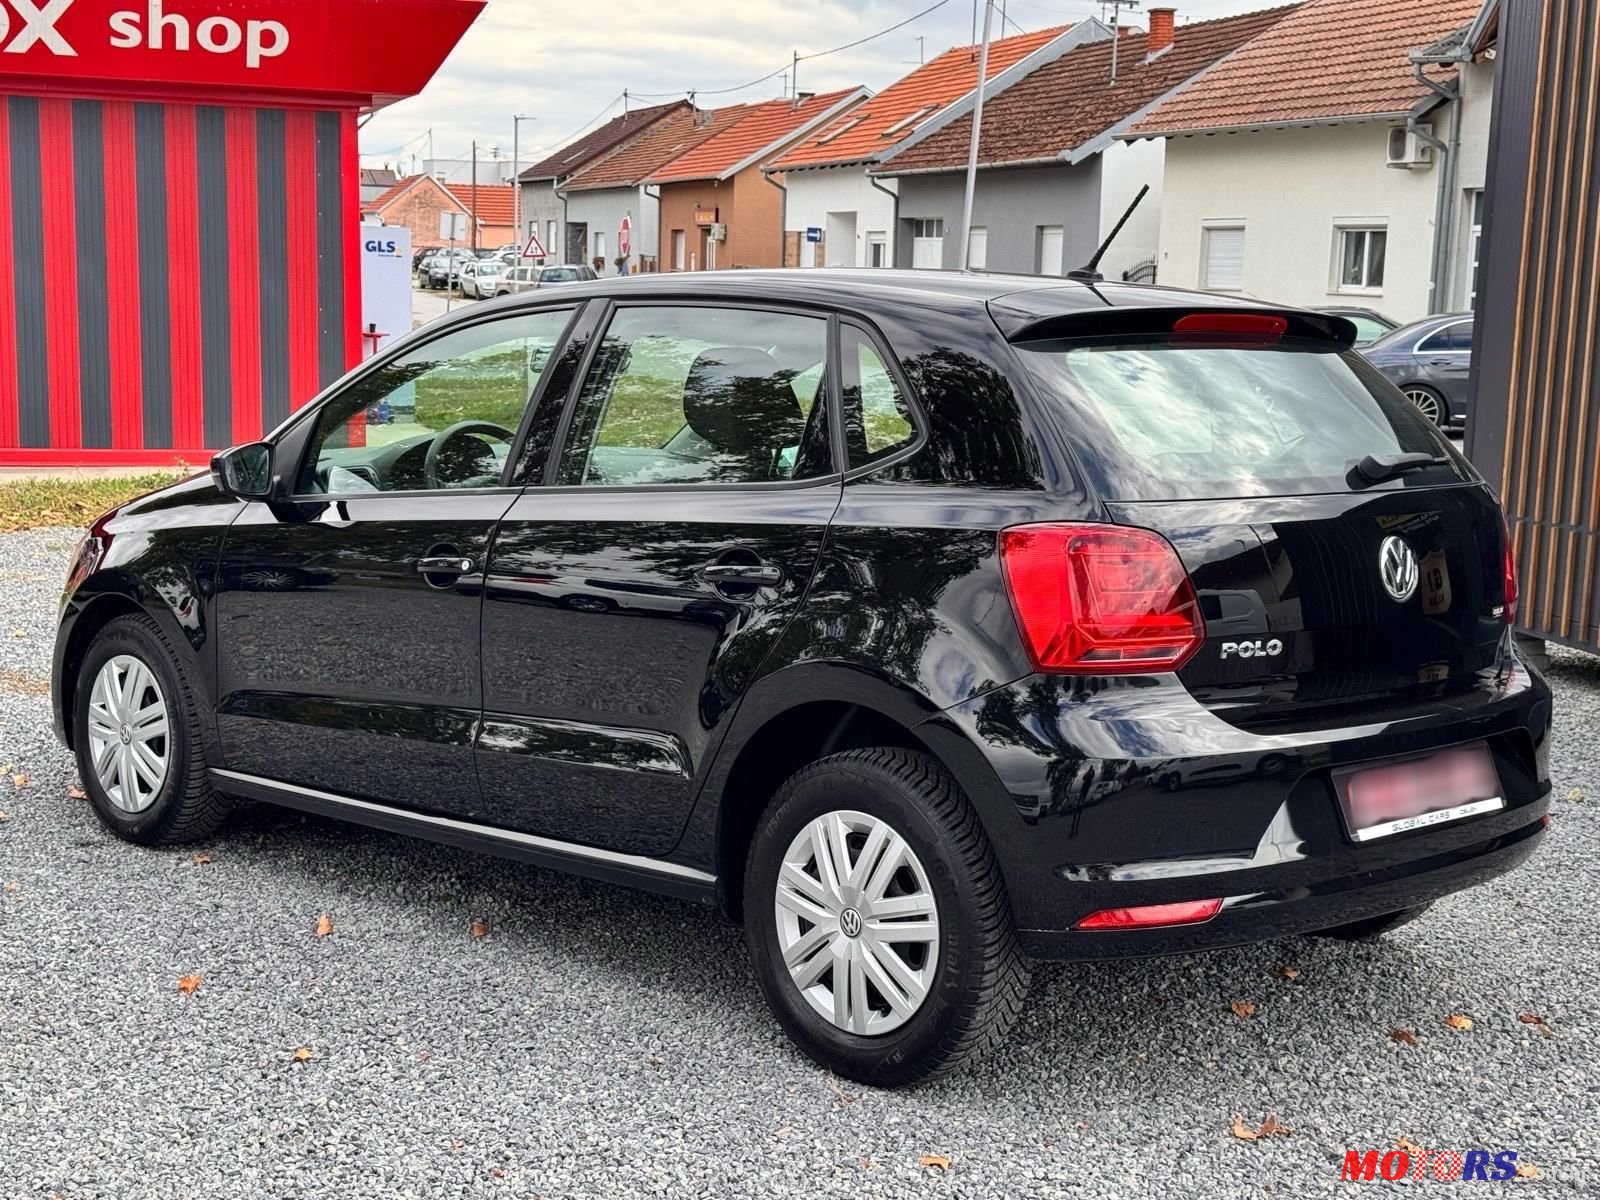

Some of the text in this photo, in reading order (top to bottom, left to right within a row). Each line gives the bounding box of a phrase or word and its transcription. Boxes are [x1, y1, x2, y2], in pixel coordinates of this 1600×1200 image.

[0, 0, 290, 69] X shop
[365, 240, 396, 253] GLS
[1220, 639, 1283, 659] POLO
[1391, 811, 1450, 832] GLOBAL CARS
